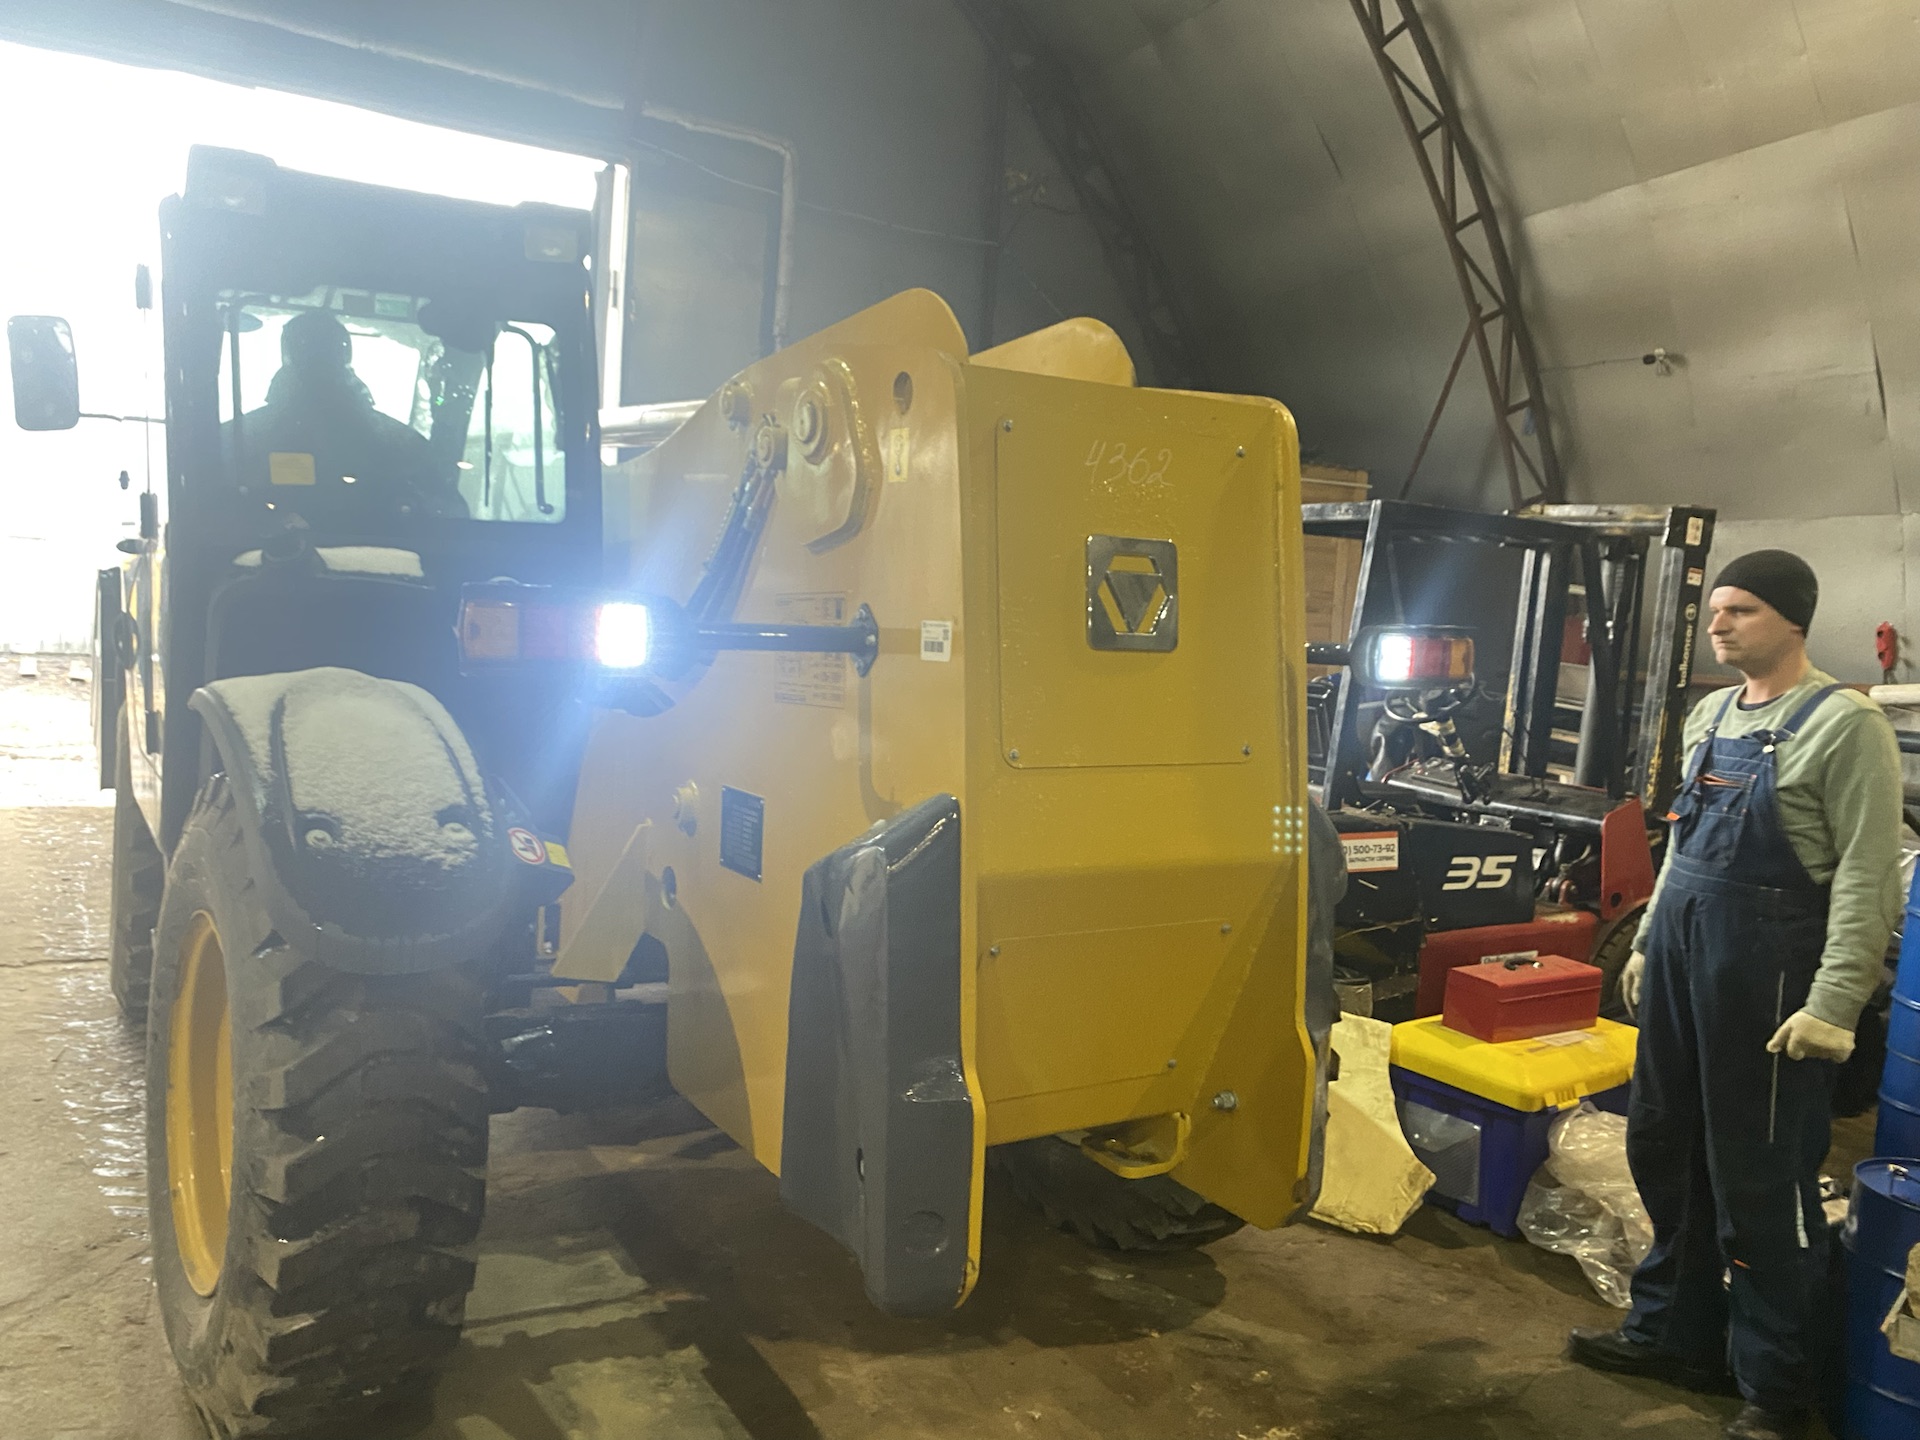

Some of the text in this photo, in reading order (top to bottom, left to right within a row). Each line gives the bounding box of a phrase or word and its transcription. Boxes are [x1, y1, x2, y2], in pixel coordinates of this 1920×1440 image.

[1084, 439, 1176, 487] 4362
[1353, 843, 1395, 855] 500-73-92
[1441, 855, 1518, 891] 35
